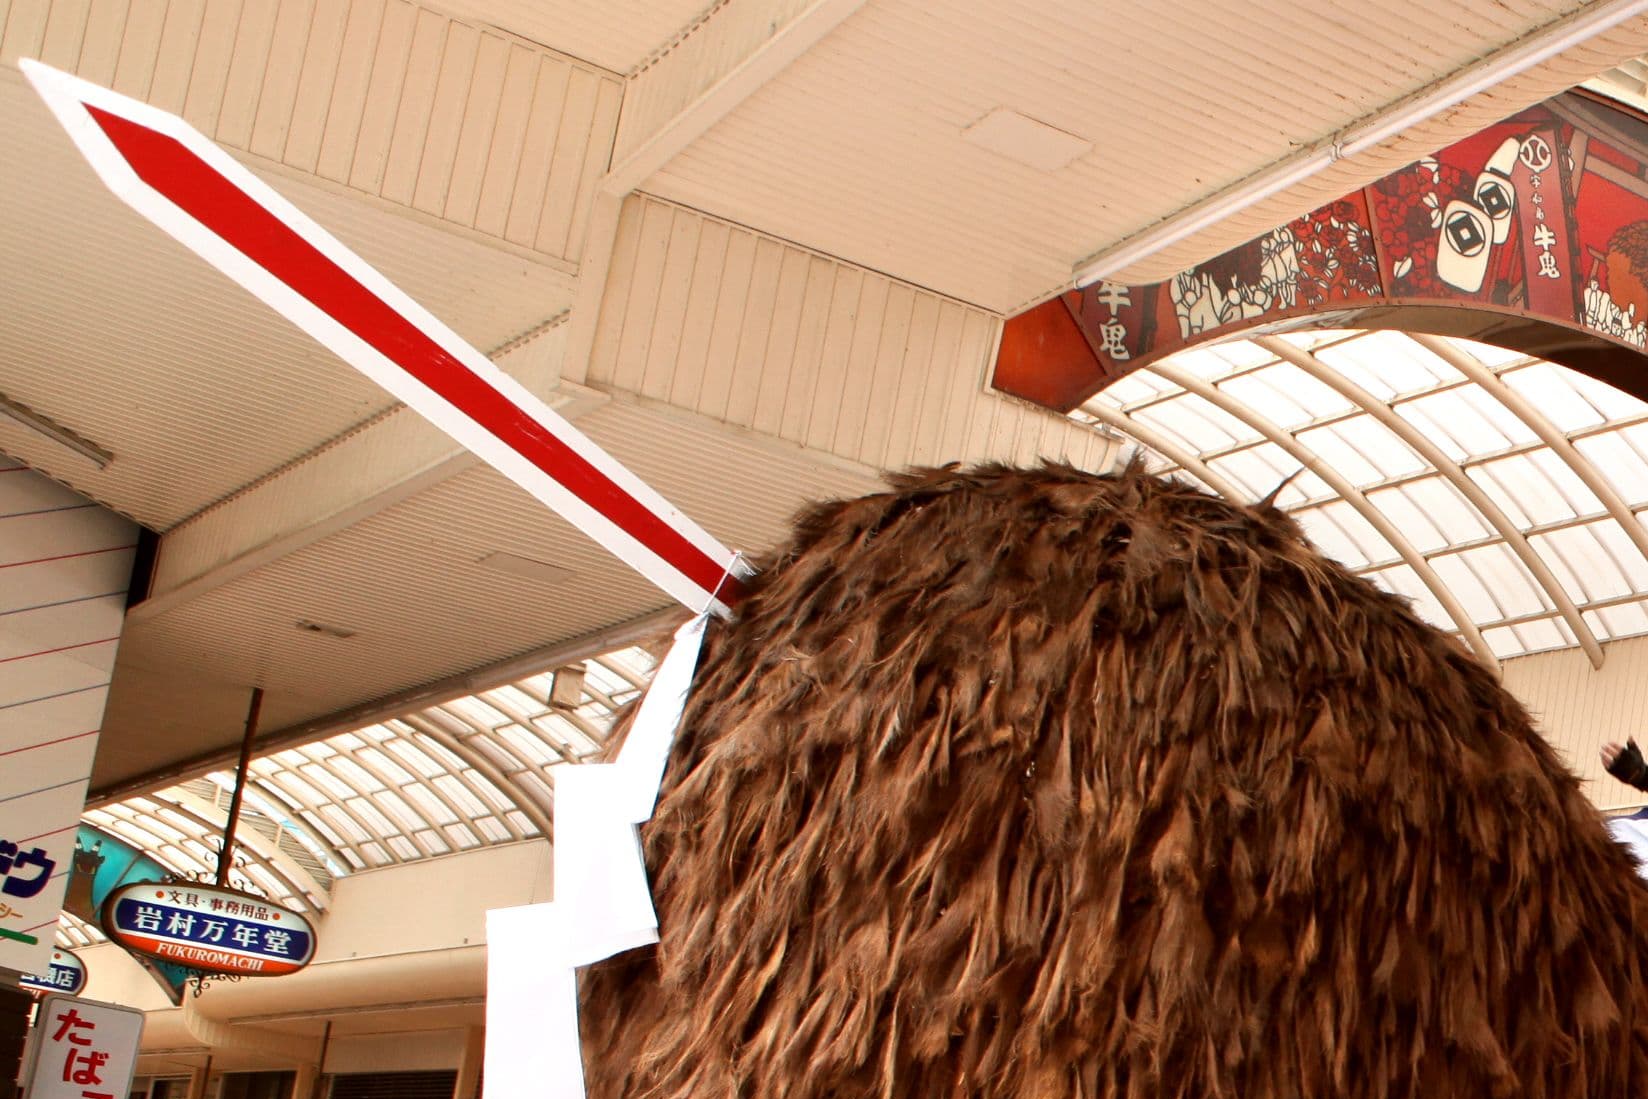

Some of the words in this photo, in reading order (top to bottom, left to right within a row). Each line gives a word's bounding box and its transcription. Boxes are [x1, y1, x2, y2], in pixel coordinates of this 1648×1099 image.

[134, 906, 293, 955] 岩村万年堂
[155, 942, 265, 972] FUKUROMACHI
